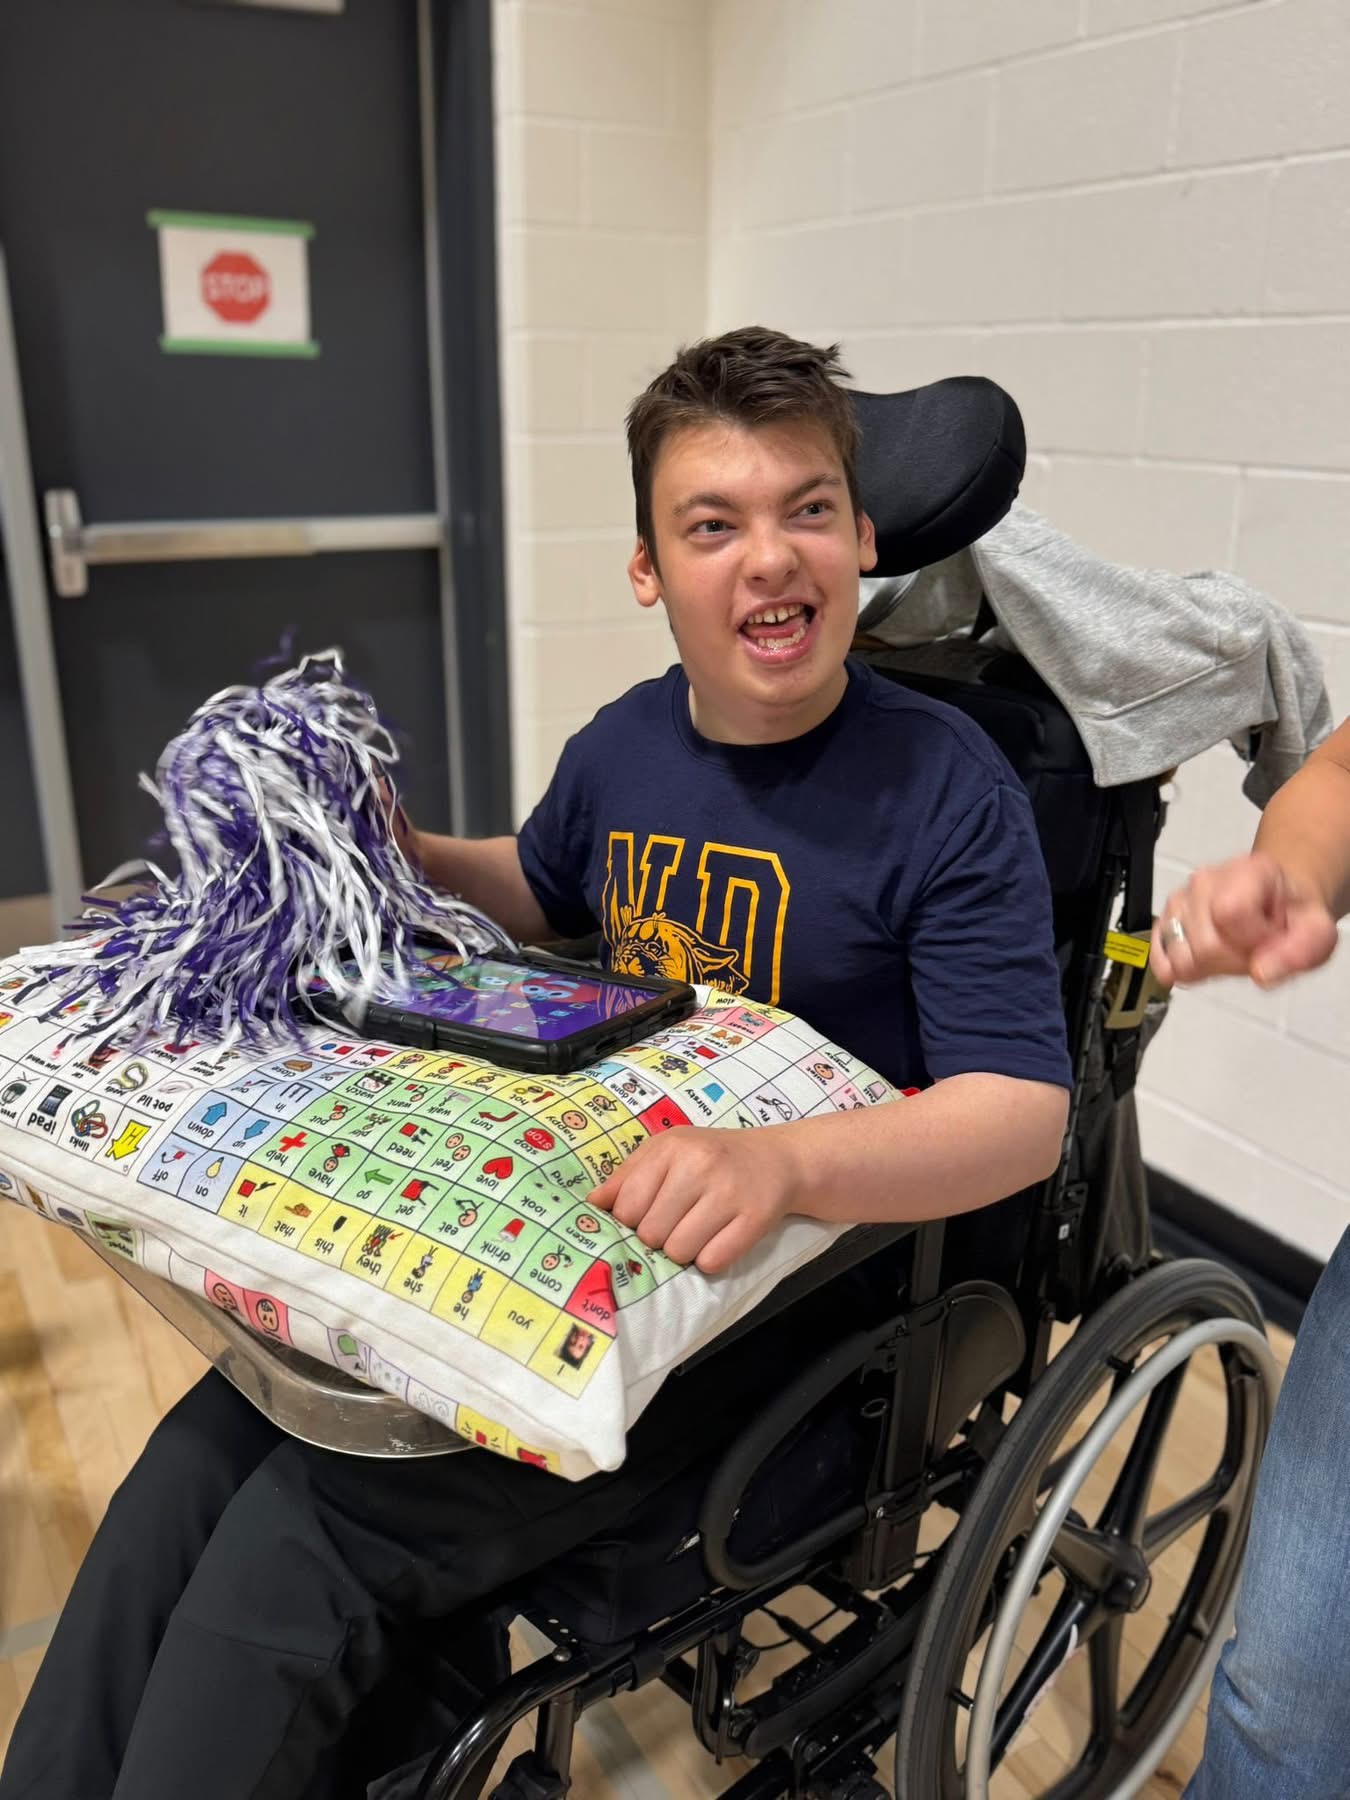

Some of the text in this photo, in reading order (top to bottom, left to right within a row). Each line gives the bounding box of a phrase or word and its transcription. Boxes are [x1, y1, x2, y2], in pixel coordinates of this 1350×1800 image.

[203, 272, 270, 303] STOP
[716, 998, 735, 1006] slow
[271, 1066, 296, 1078] close
[345, 1085, 375, 1100] watch
[508, 1093, 530, 1106] hot
[609, 1083, 629, 1101] done
[137, 1094, 173, 1114] pot lid
[275, 1103, 287, 1112] in
[386, 1098, 412, 1109] want
[426, 1105, 451, 1117] walk
[583, 1101, 604, 1117] sad
[684, 1088, 714, 1117] thirsty
[27, 1113, 56, 1135] iPad
[309, 1115, 330, 1126] put
[759, 1108, 770, 1123] fix
[186, 1122, 214, 1140] down
[469, 1118, 494, 1132] turn
[545, 1114, 577, 1142] happy
[69, 1136, 90, 1152] links
[232, 1139, 246, 1148] up
[513, 1138, 540, 1156] stop
[527, 1128, 553, 1149] STOP
[265, 1149, 289, 1167] help
[386, 1141, 416, 1160] need
[429, 1158, 454, 1171] feel
[584, 1155, 606, 1184] good
[152, 1168, 169, 1182] off
[308, 1168, 334, 1188] have
[475, 1175, 500, 1191] love
[195, 1184, 208, 1198] on
[356, 1189, 373, 1200] go
[239, 1204, 248, 1218] it
[394, 1204, 415, 1217] get
[520, 1195, 547, 1217] look
[274, 1220, 296, 1238] that
[438, 1222, 459, 1238] eat
[314, 1238, 334, 1255] this
[565, 1226, 598, 1250] listen
[479, 1240, 511, 1264] drink
[356, 1256, 383, 1276] they
[529, 1269, 562, 1293] come
[614, 1263, 630, 1289] like
[403, 1278, 424, 1295] she
[453, 1303, 470, 1321] he
[581, 1298, 611, 1321] don't
[507, 1309, 534, 1331] you
[556, 1363, 566, 1376] I
